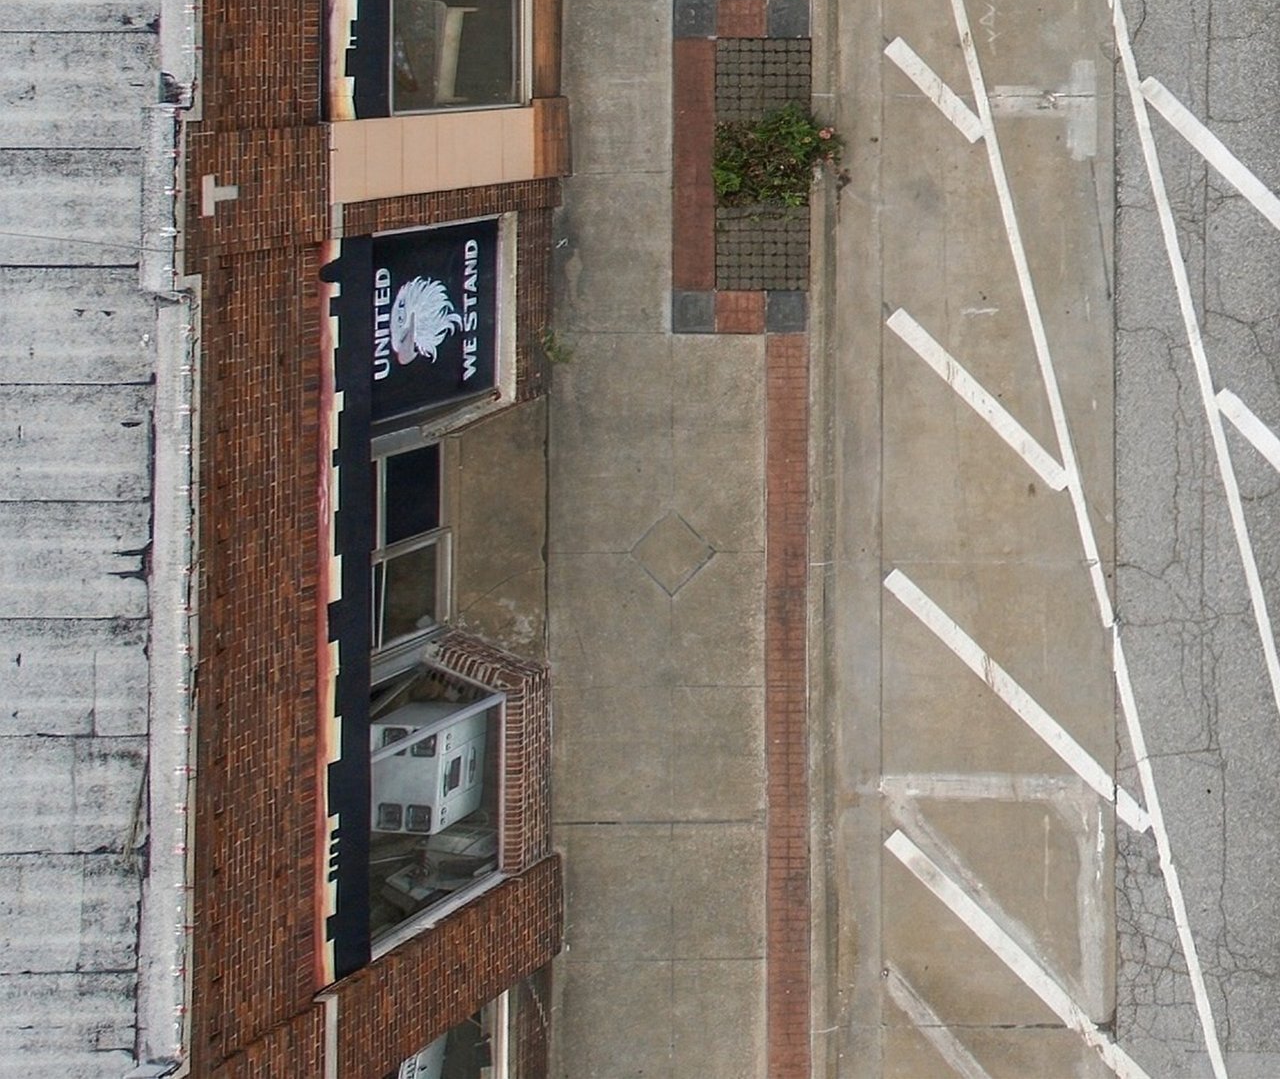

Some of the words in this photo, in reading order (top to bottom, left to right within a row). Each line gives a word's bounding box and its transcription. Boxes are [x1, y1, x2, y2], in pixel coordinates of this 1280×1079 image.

[374, 268, 391, 381] UNITED
[463, 239, 478, 332] STAND
[463, 337, 477, 381] WE
